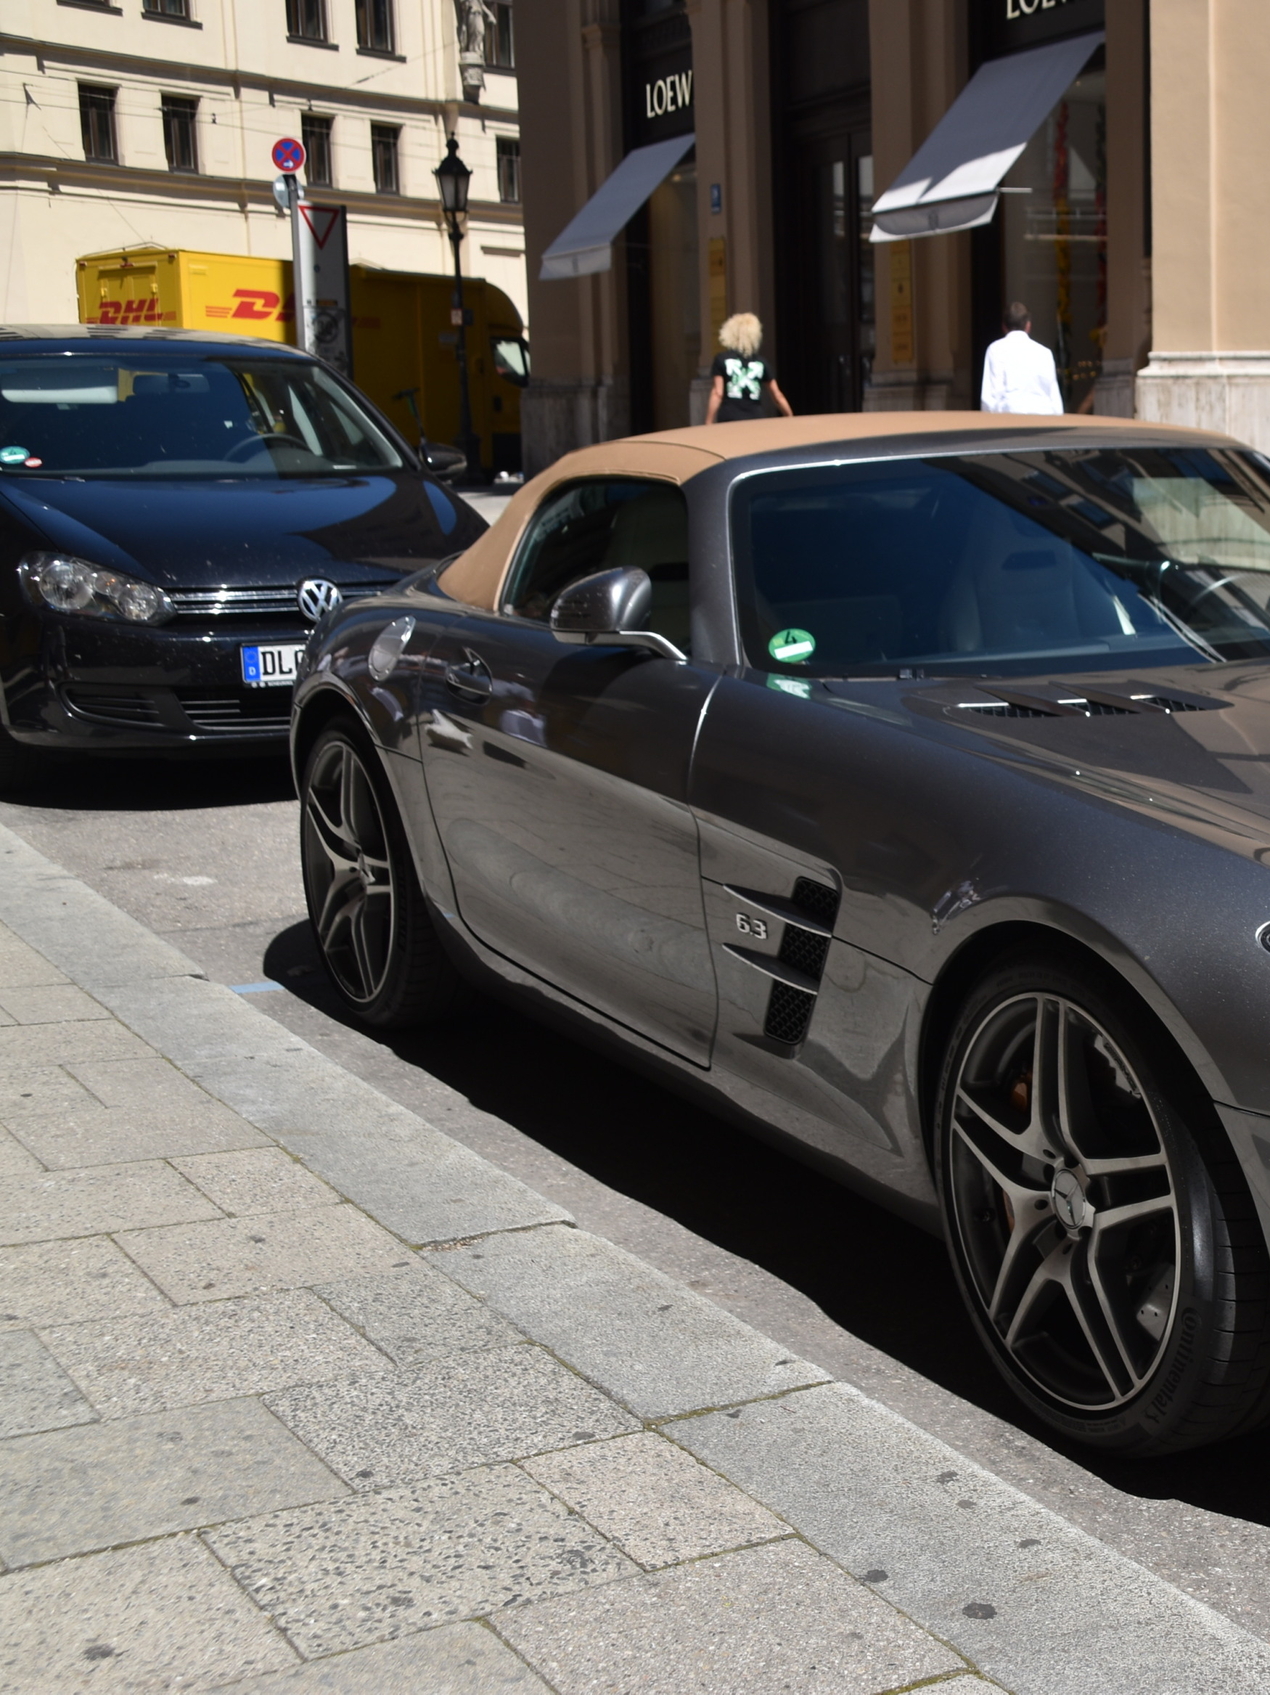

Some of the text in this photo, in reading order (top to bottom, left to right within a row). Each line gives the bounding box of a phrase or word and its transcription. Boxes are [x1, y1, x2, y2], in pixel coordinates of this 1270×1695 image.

[646, 69, 692, 118] LOEW
[98, 298, 163, 324] DHL
[1151, 1306, 1203, 1417] Continental
